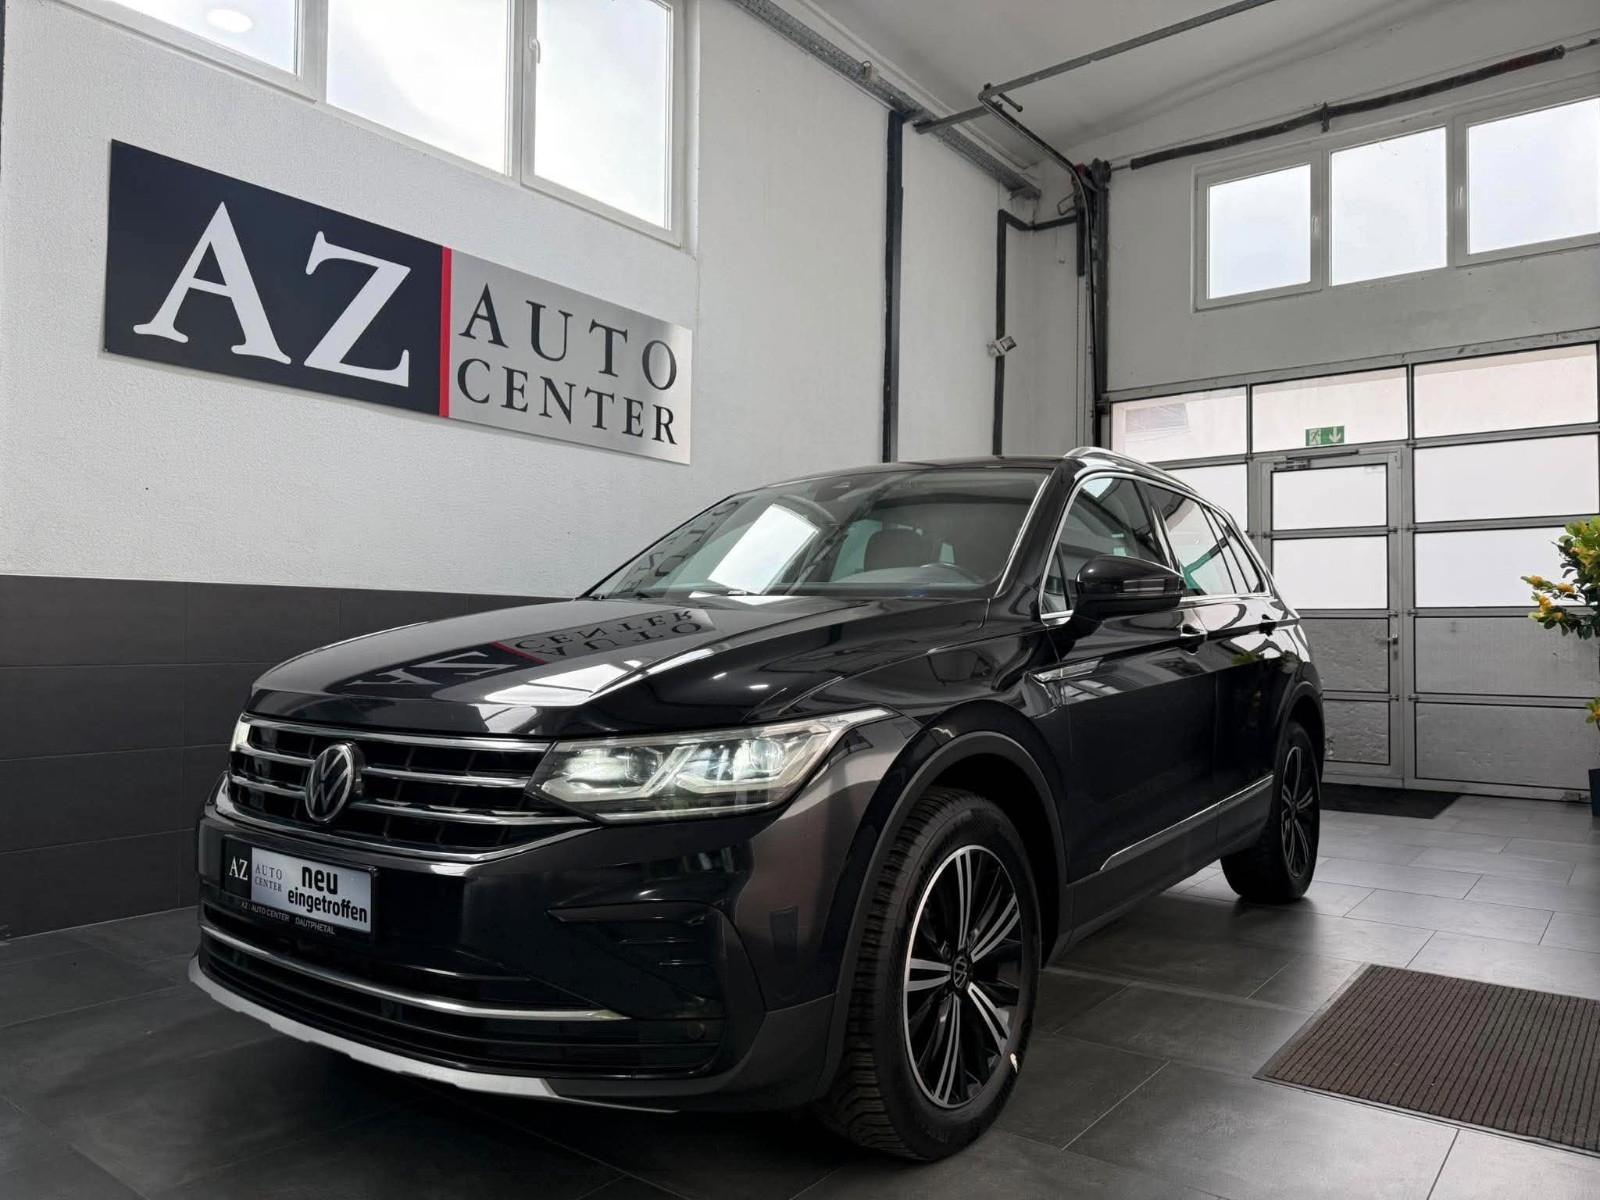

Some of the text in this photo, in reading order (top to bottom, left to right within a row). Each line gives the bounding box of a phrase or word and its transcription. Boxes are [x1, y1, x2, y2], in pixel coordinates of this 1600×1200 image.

[133, 201, 411, 388] AZ
[457, 282, 678, 391] AUTO
[456, 357, 678, 446] CENTER
[229, 855, 249, 881] AZ
[254, 876, 283, 893] CENTER
[255, 863, 283, 881] AUTO
[301, 865, 338, 896] neu
[287, 886, 368, 924] eingetroffen
